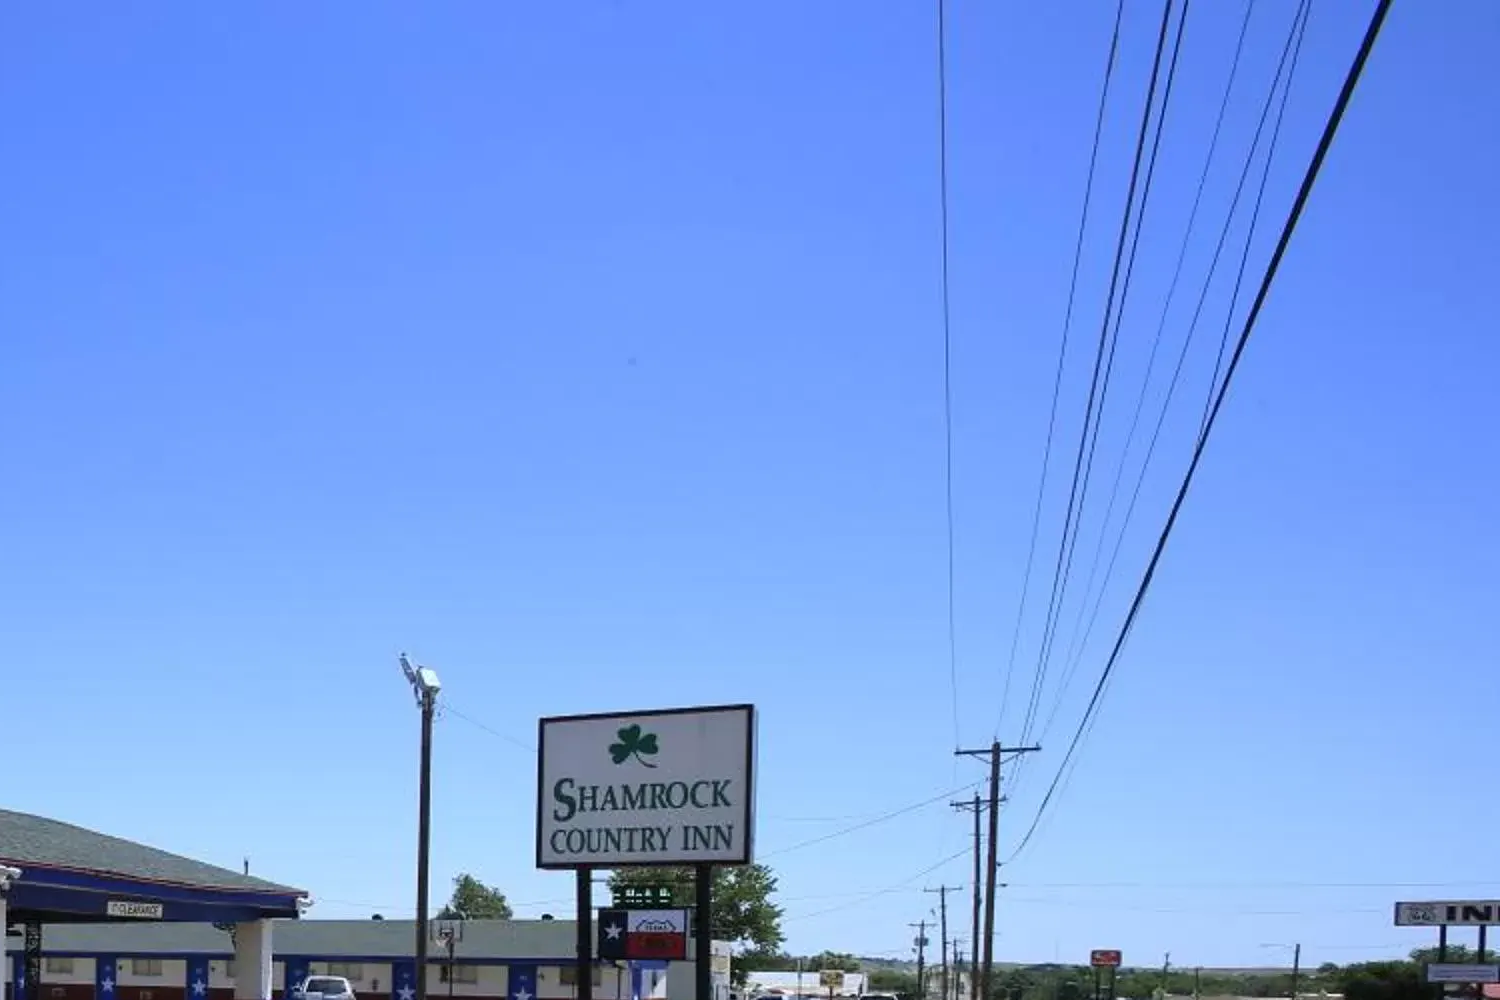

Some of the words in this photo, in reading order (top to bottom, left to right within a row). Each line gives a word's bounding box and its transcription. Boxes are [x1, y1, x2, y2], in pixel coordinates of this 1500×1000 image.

[553, 777, 732, 822] SHAMROCK
[550, 826, 671, 855] COUNTRY
[682, 824, 734, 851] INN
